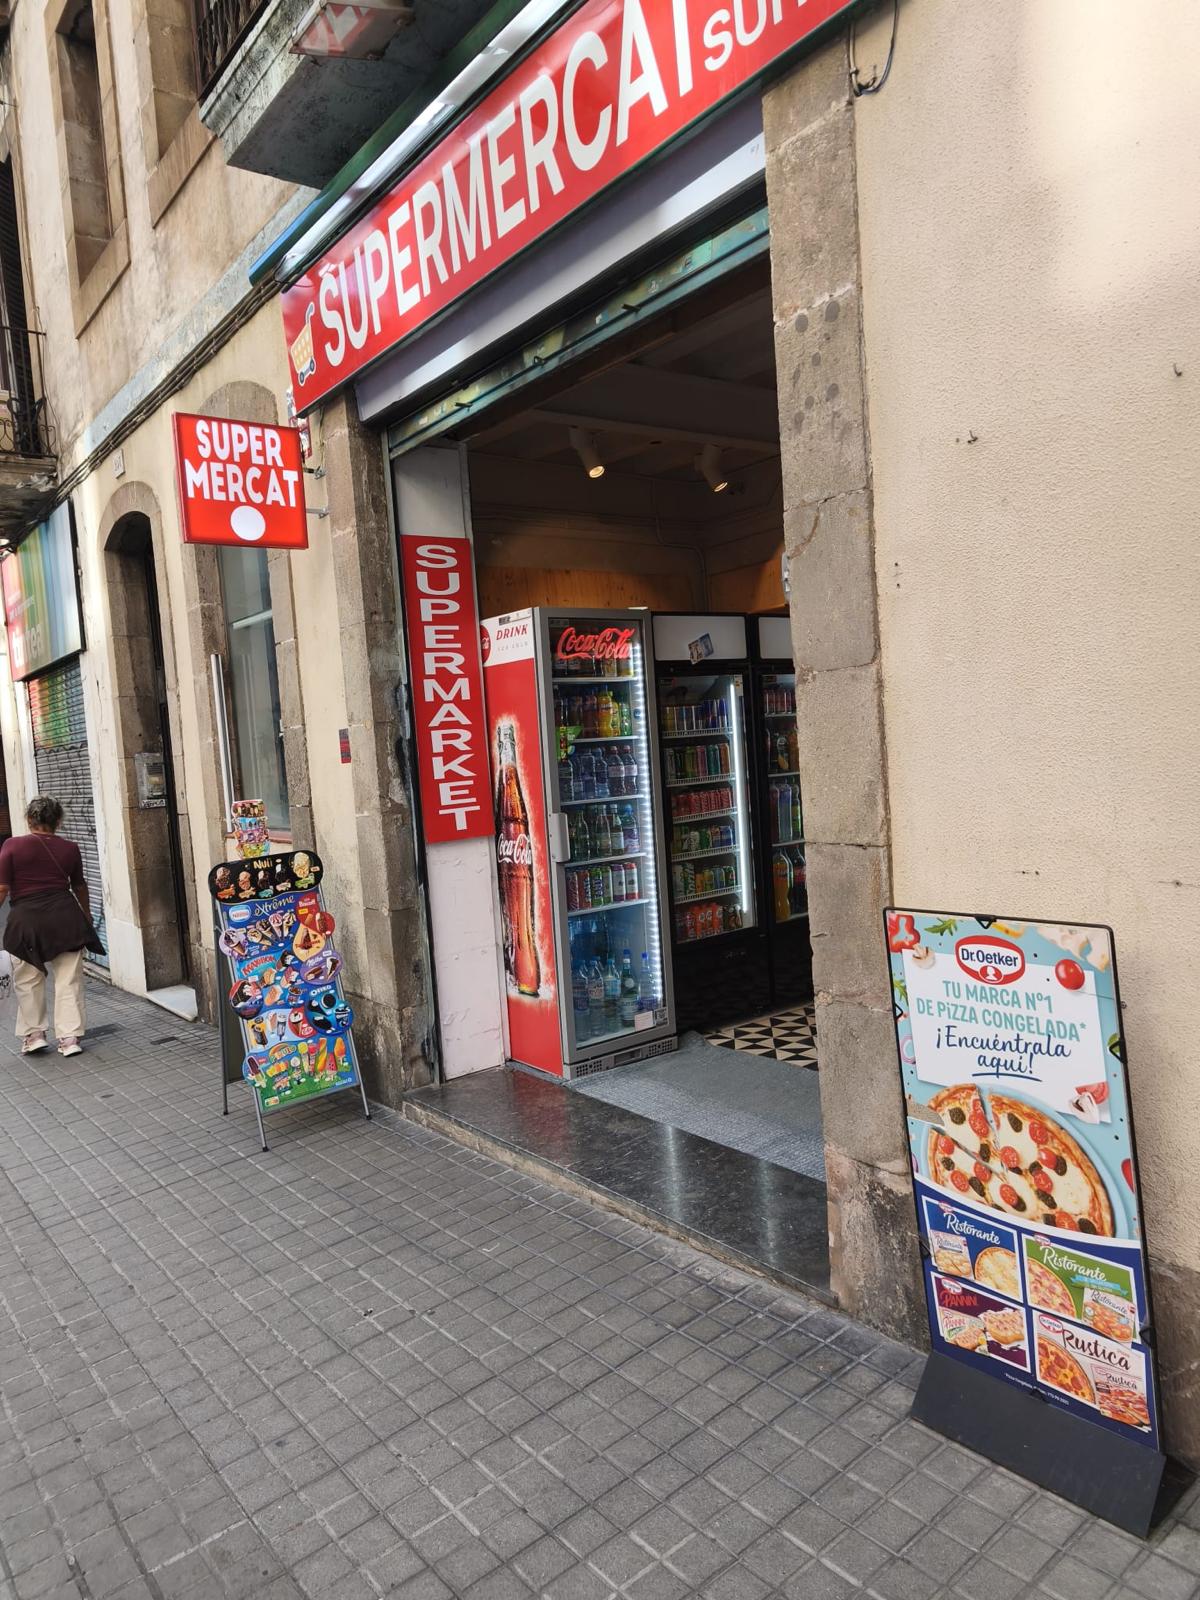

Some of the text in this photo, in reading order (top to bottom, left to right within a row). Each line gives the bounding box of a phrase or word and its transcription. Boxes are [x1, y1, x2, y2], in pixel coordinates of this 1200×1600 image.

[196, 420, 284, 467] SUPER
[185, 458, 298, 507] MERCAT
[496, 624, 528, 640] DRINK
[557, 626, 635, 660] Coca-Cola
[416, 544, 480, 831] SUPERMARKET
[497, 833, 531, 865] Coca-Cola
[916, 997, 935, 1016] DE
[942, 980, 961, 998] TU
[965, 983, 1022, 1008] MARCA
[936, 1025, 1071, 1057] ¡Encuéntrala
[943, 1212, 1000, 1245] Ristorante
[1040, 1245, 1107, 1281] Ristorante
[1091, 1288, 1128, 1315] Ristorante
[1062, 1329, 1130, 1370] Rustica
[1105, 1372, 1138, 1389] Rustica
